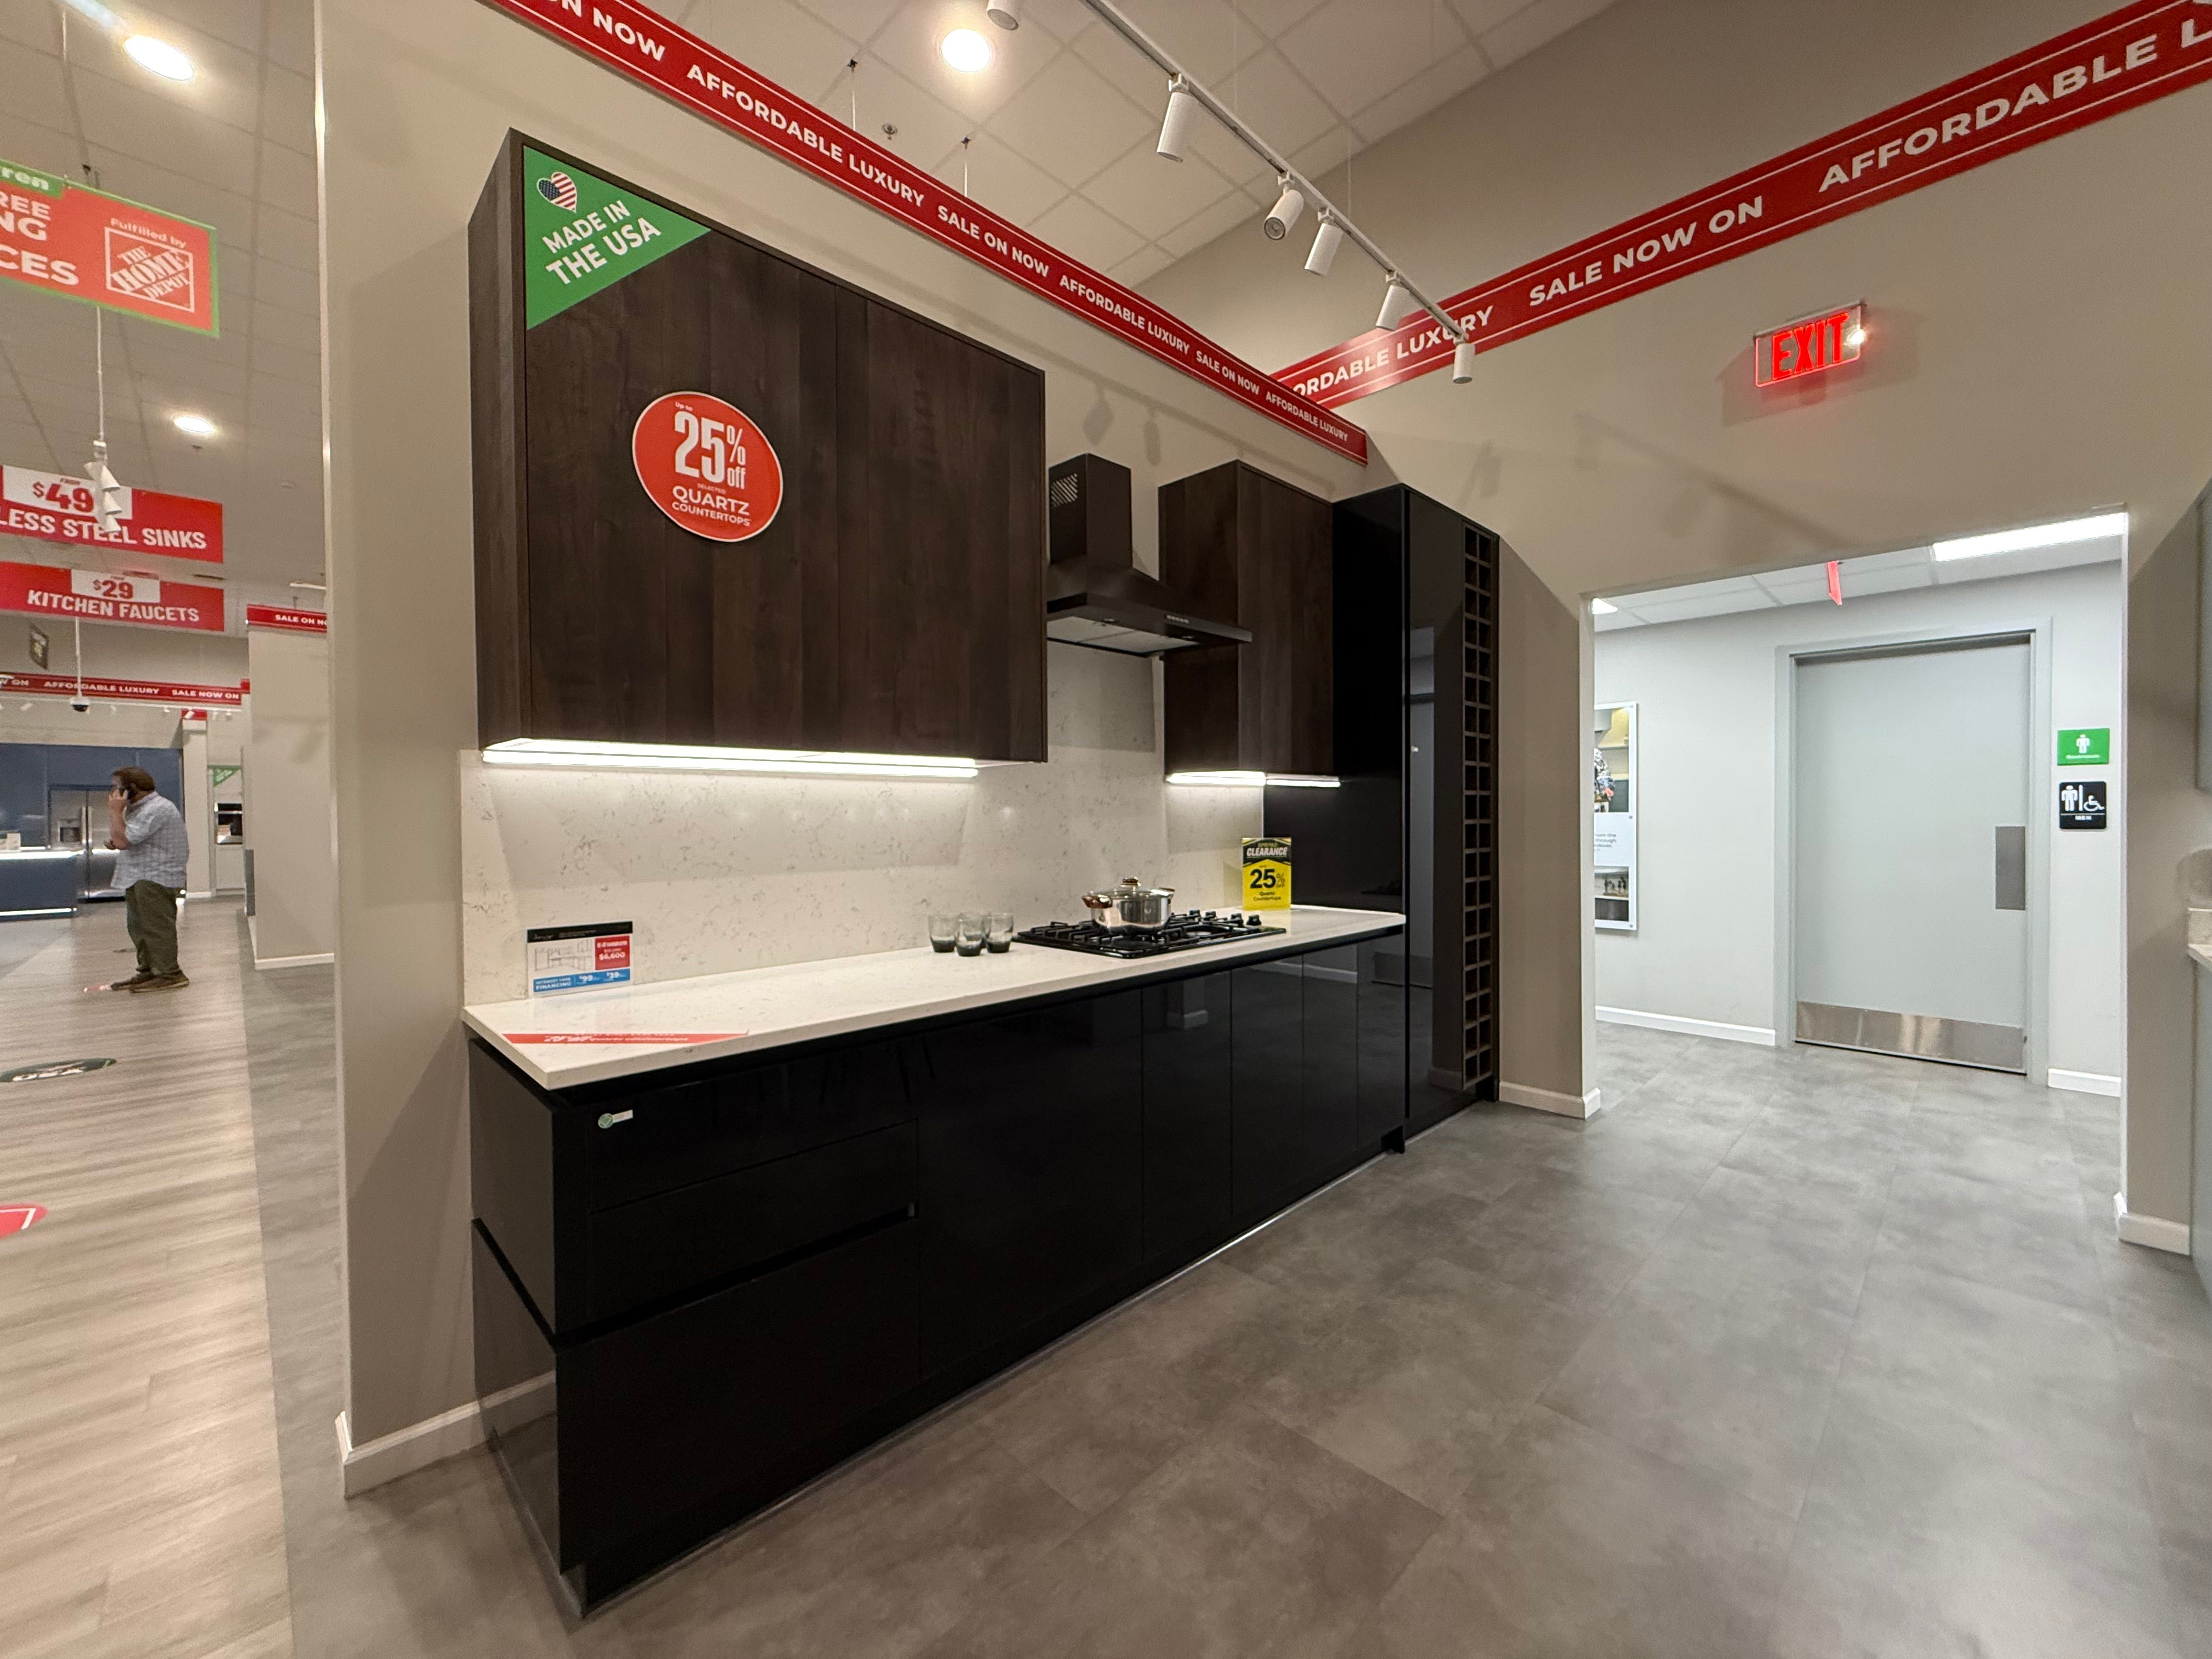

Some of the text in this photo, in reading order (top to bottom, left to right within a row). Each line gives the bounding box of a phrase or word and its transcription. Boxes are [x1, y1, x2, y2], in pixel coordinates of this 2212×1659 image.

[1529, 262, 1603, 307] SALE
[1613, 223, 1697, 273] NOW
[1708, 196, 1763, 234] ON
[1819, 33, 2158, 193] AFFORDABLE
[111, 218, 187, 249] Fulfilled by
[543, 200, 630, 254] MADE IN
[593, 7, 665, 61] NOW
[687, 64, 843, 163] AFFORDABLE
[849, 154, 924, 207] LUXURY
[938, 205, 980, 240] SALE
[984, 232, 1007, 255] ON
[1012, 247, 1049, 277] NOW
[1059, 275, 1144, 330] AFFORDABLE
[1148, 320, 1189, 354] LUXURY
[1197, 351, 1220, 373] SALE
[1222, 364, 1235, 382] ON
[1238, 374, 1260, 396] NOW
[1266, 391, 1318, 427] AFFORDABLE
[1319, 421, 1348, 442] LUXURY
[117, 246, 151, 265] THE
[546, 217, 662, 285] THE USA
[110, 251, 189, 291] HOME
[143, 273, 189, 299] DEPOT
[1772, 313, 1849, 381] EXIT
[675, 411, 746, 483] 25%
[697, 483, 726, 495] SELECTED
[727, 466, 746, 490] off
[33, 481, 94, 512] $49
[673, 486, 751, 516] QUARTZ
[672, 501, 751, 527] COUNTERTOPS
[142, 528, 207, 549] SINKS
[93, 579, 133, 600] $29
[28, 590, 200, 622] KITCHEN FAUCETS
[275, 614, 298, 623] SALE
[119, 685, 159, 695] LUXURY
[172, 689, 196, 697] SALE
[1246, 847, 1288, 856] CLEARANCE
[599, 952, 625, 961] $6,600
